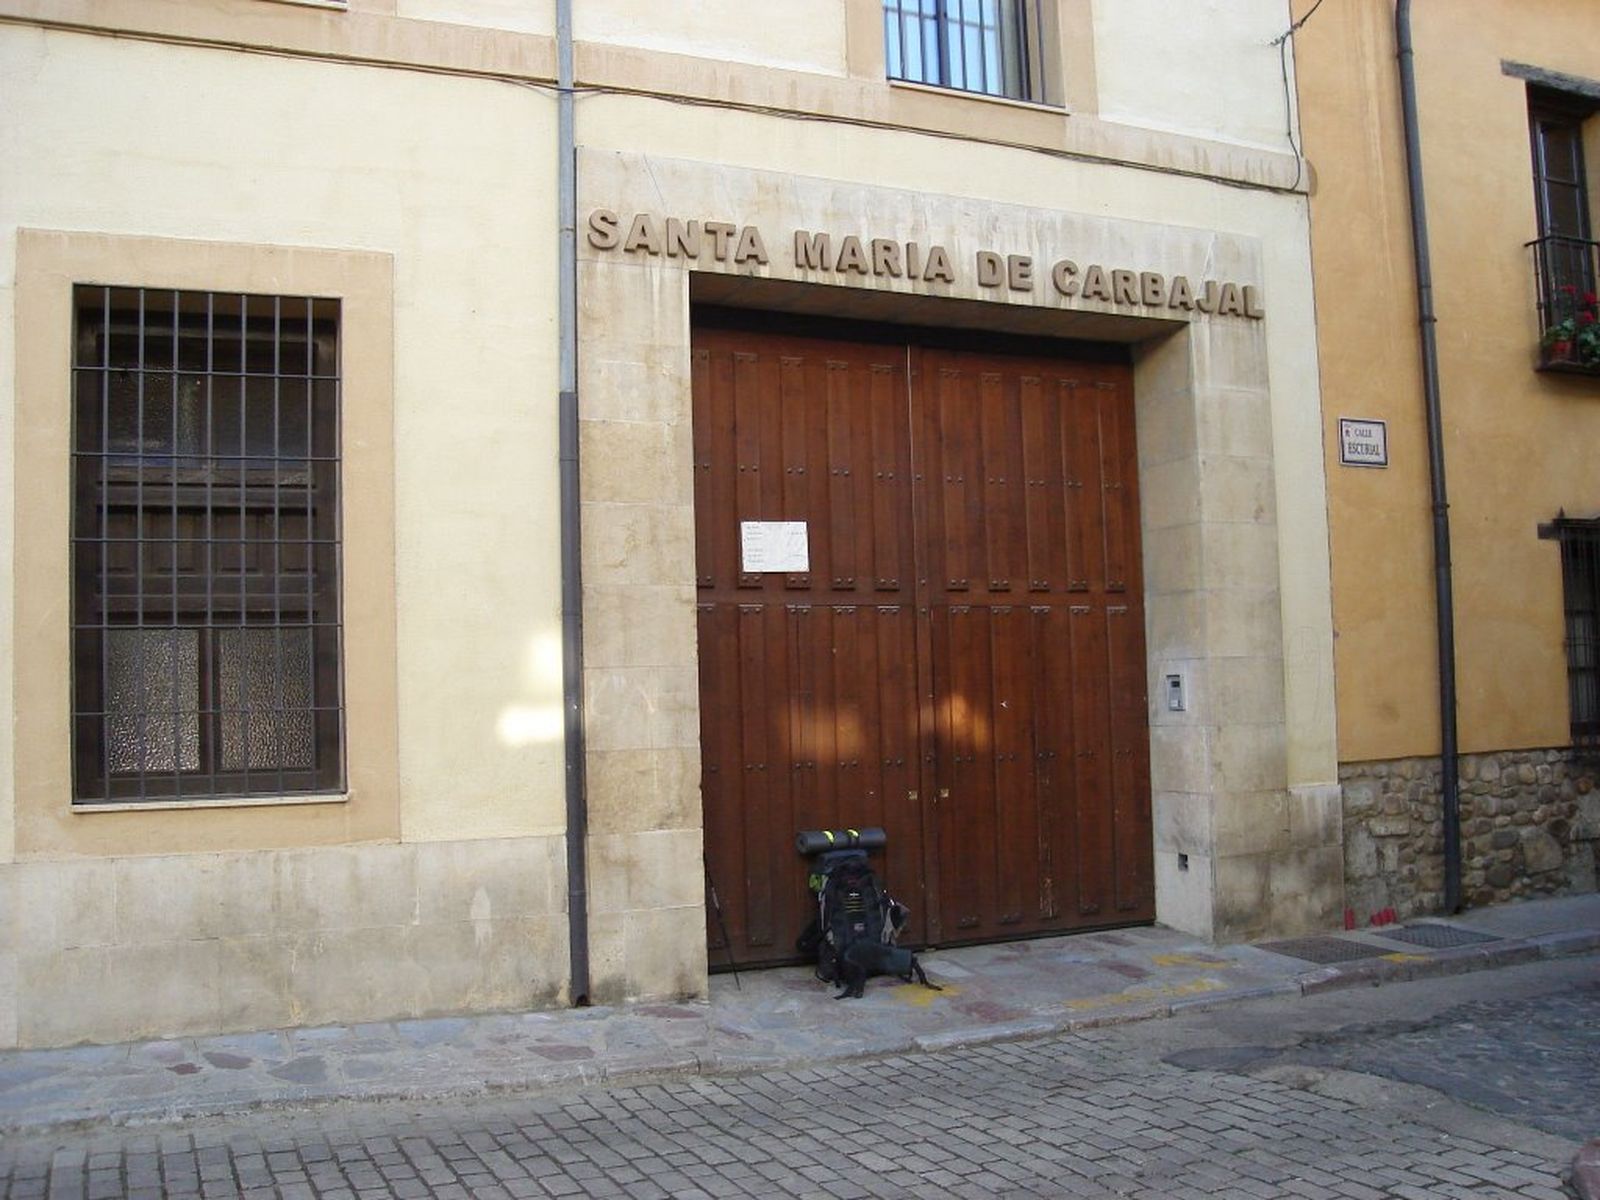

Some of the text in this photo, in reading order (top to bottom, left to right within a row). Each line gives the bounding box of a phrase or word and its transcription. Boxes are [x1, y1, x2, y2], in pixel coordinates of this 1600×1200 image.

[586, 209, 1265, 319] SANTA MARIA DE CARBAJAL
